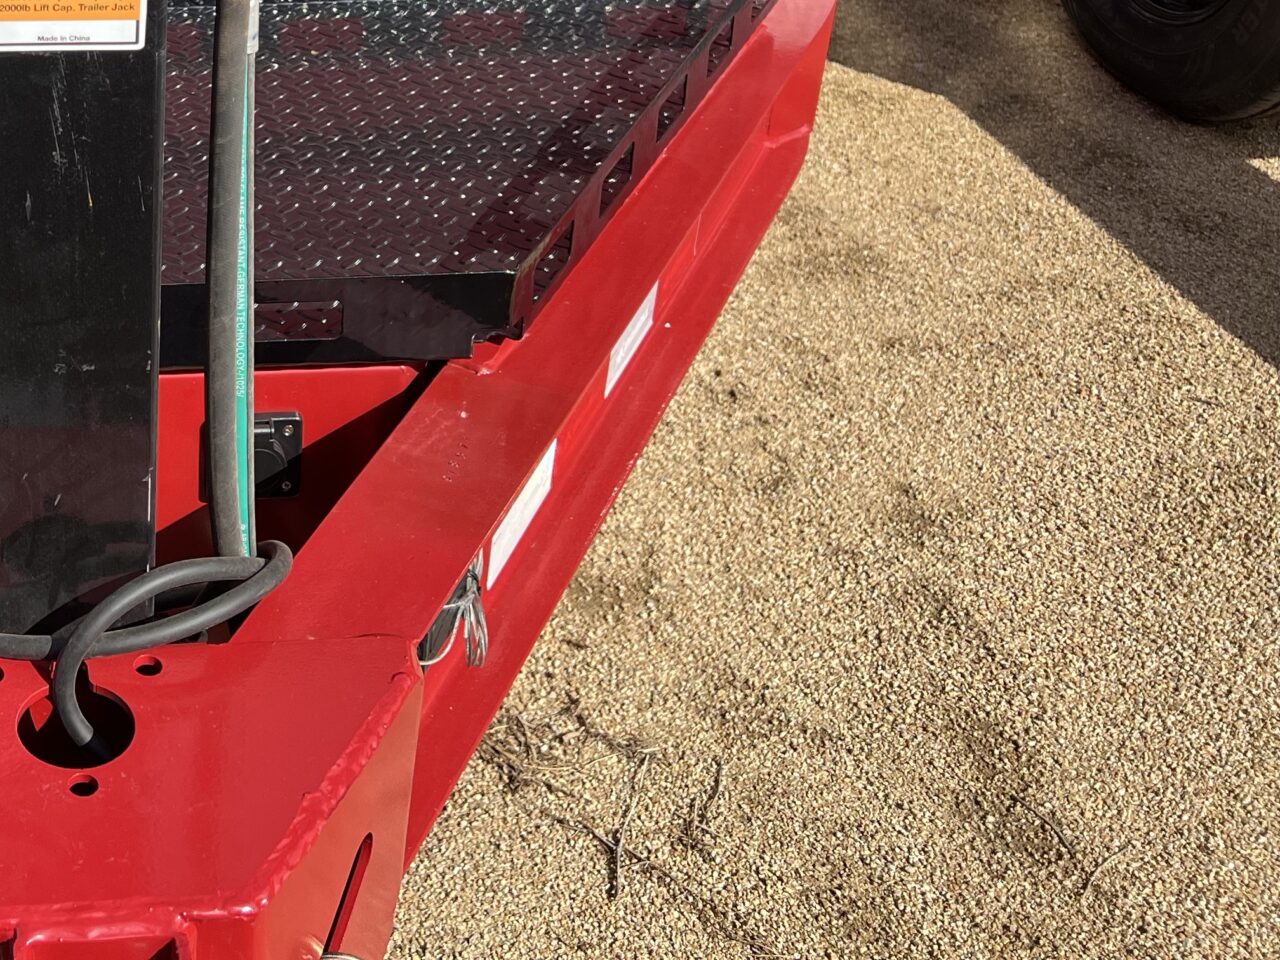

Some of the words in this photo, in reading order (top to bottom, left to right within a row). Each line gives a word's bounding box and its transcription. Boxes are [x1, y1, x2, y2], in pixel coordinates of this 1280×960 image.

[33, 3, 50, 12] Lift
[52, 3, 76, 13] Cap.
[79, 3, 109, 12] Trailer
[111, 3, 135, 11] Jack
